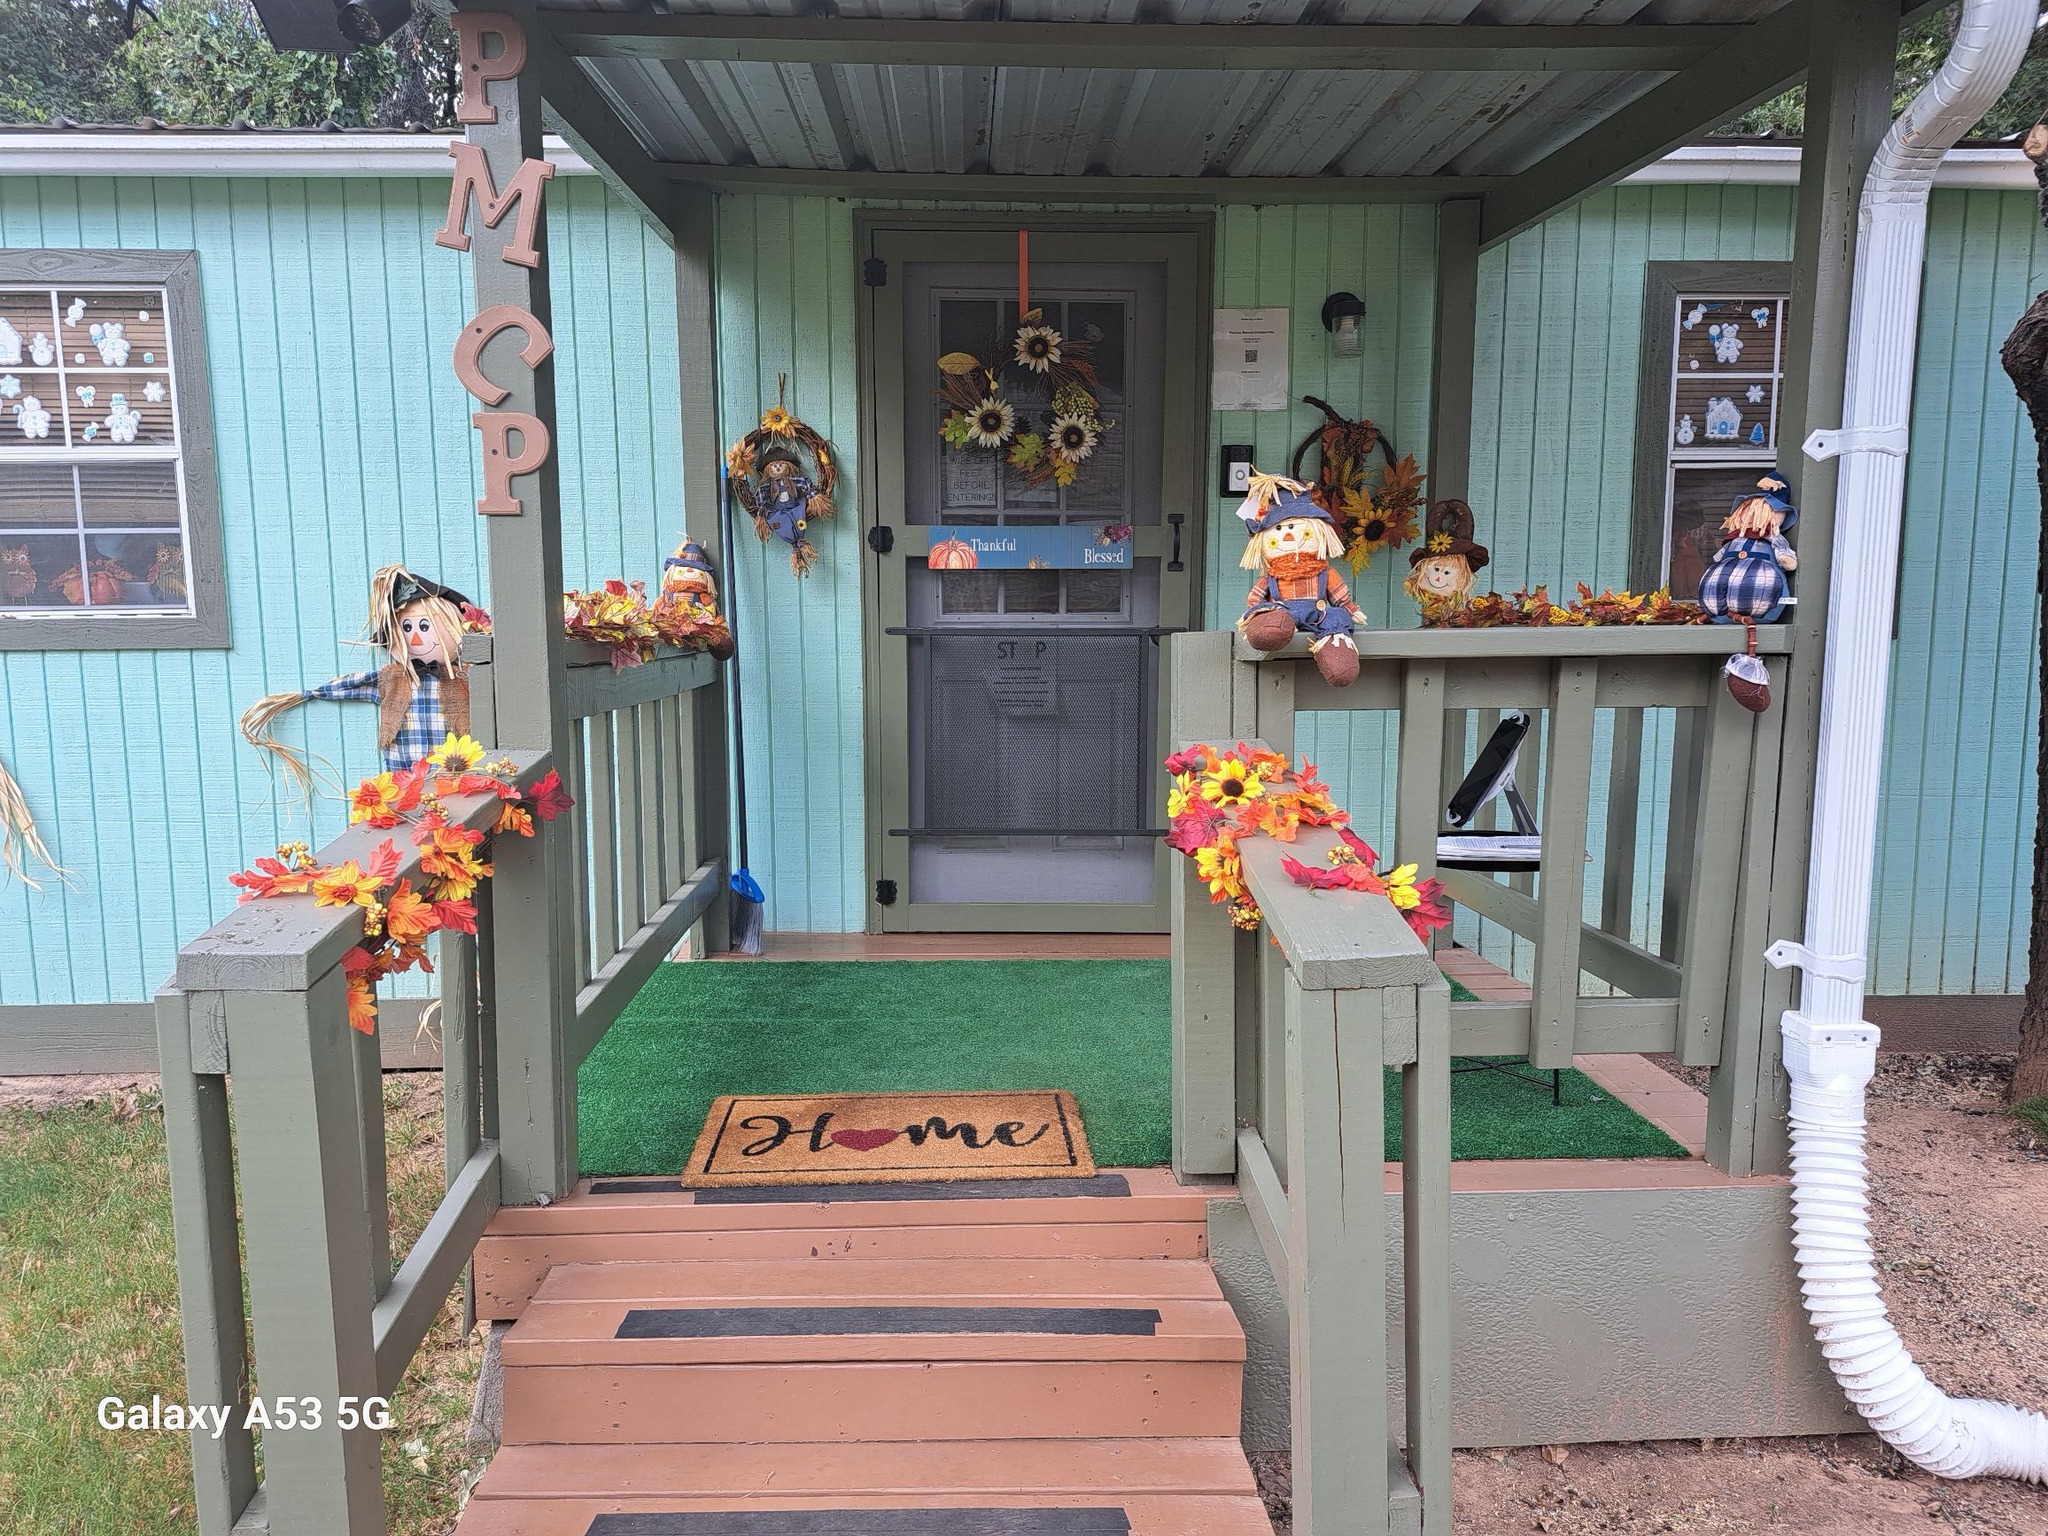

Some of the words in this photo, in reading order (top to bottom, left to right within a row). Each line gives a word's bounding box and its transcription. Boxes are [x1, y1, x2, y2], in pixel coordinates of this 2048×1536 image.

[959, 468, 983, 478] FEET
[953, 481, 990, 490] BEFORE
[970, 538, 1017, 552] Thankful
[1083, 547, 1124, 564] Blessed
[997, 640, 1047, 660] STP
